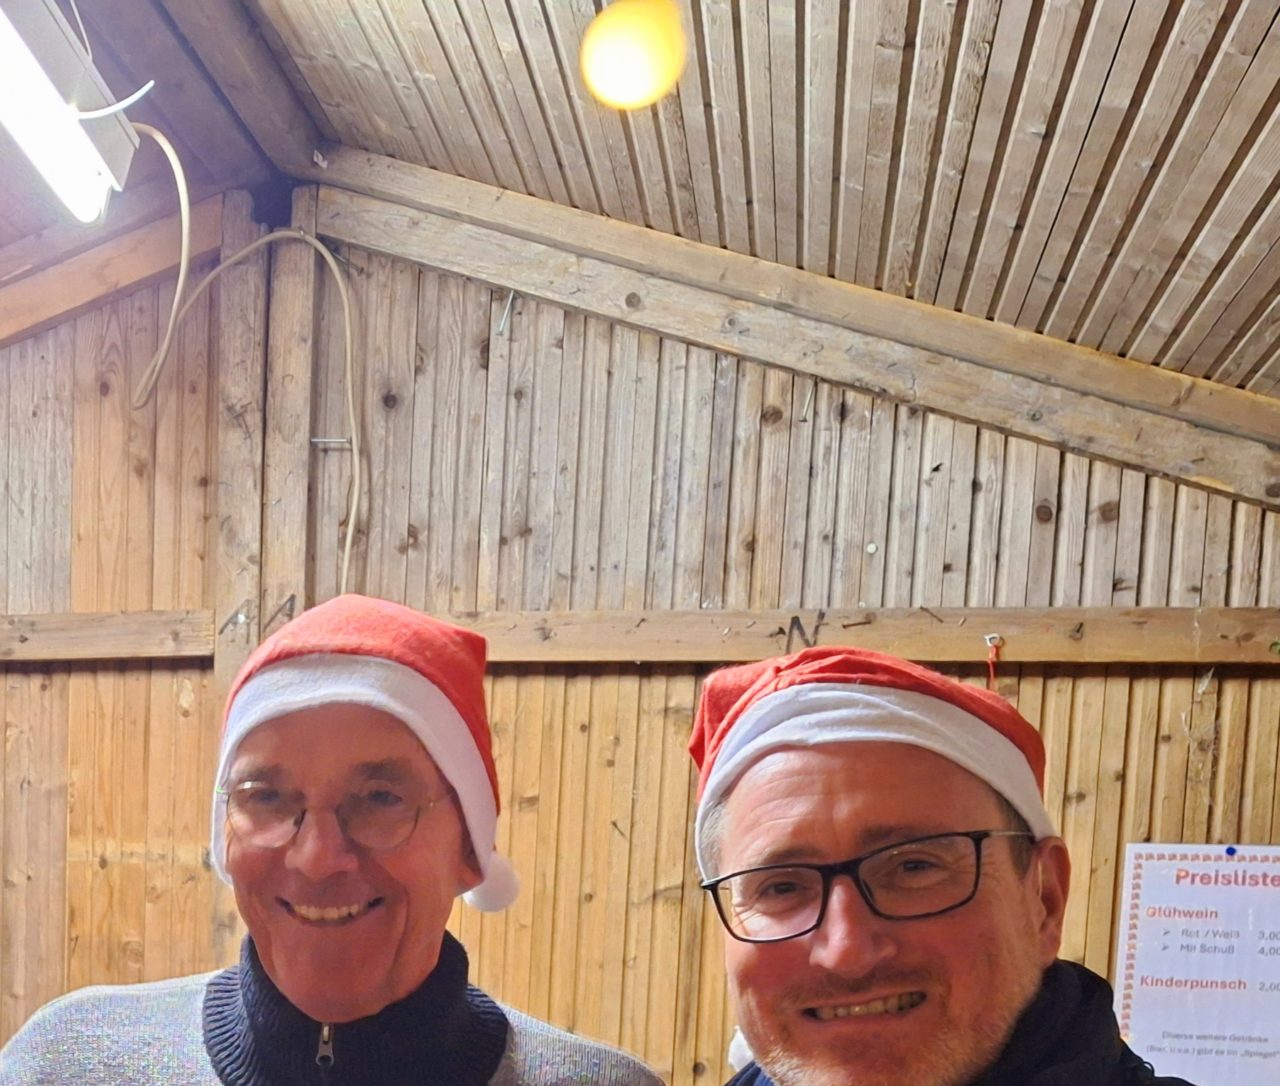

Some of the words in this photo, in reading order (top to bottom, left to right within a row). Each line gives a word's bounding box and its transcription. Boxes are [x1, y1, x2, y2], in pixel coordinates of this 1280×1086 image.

[1175, 868, 1280, 887] Preisliste
[1146, 906, 1219, 919] Glühwein
[1181, 928, 1200, 938] Rot
[1180, 943, 1197, 953] Mit
[1140, 975, 1247, 990] Kinderpunsch
